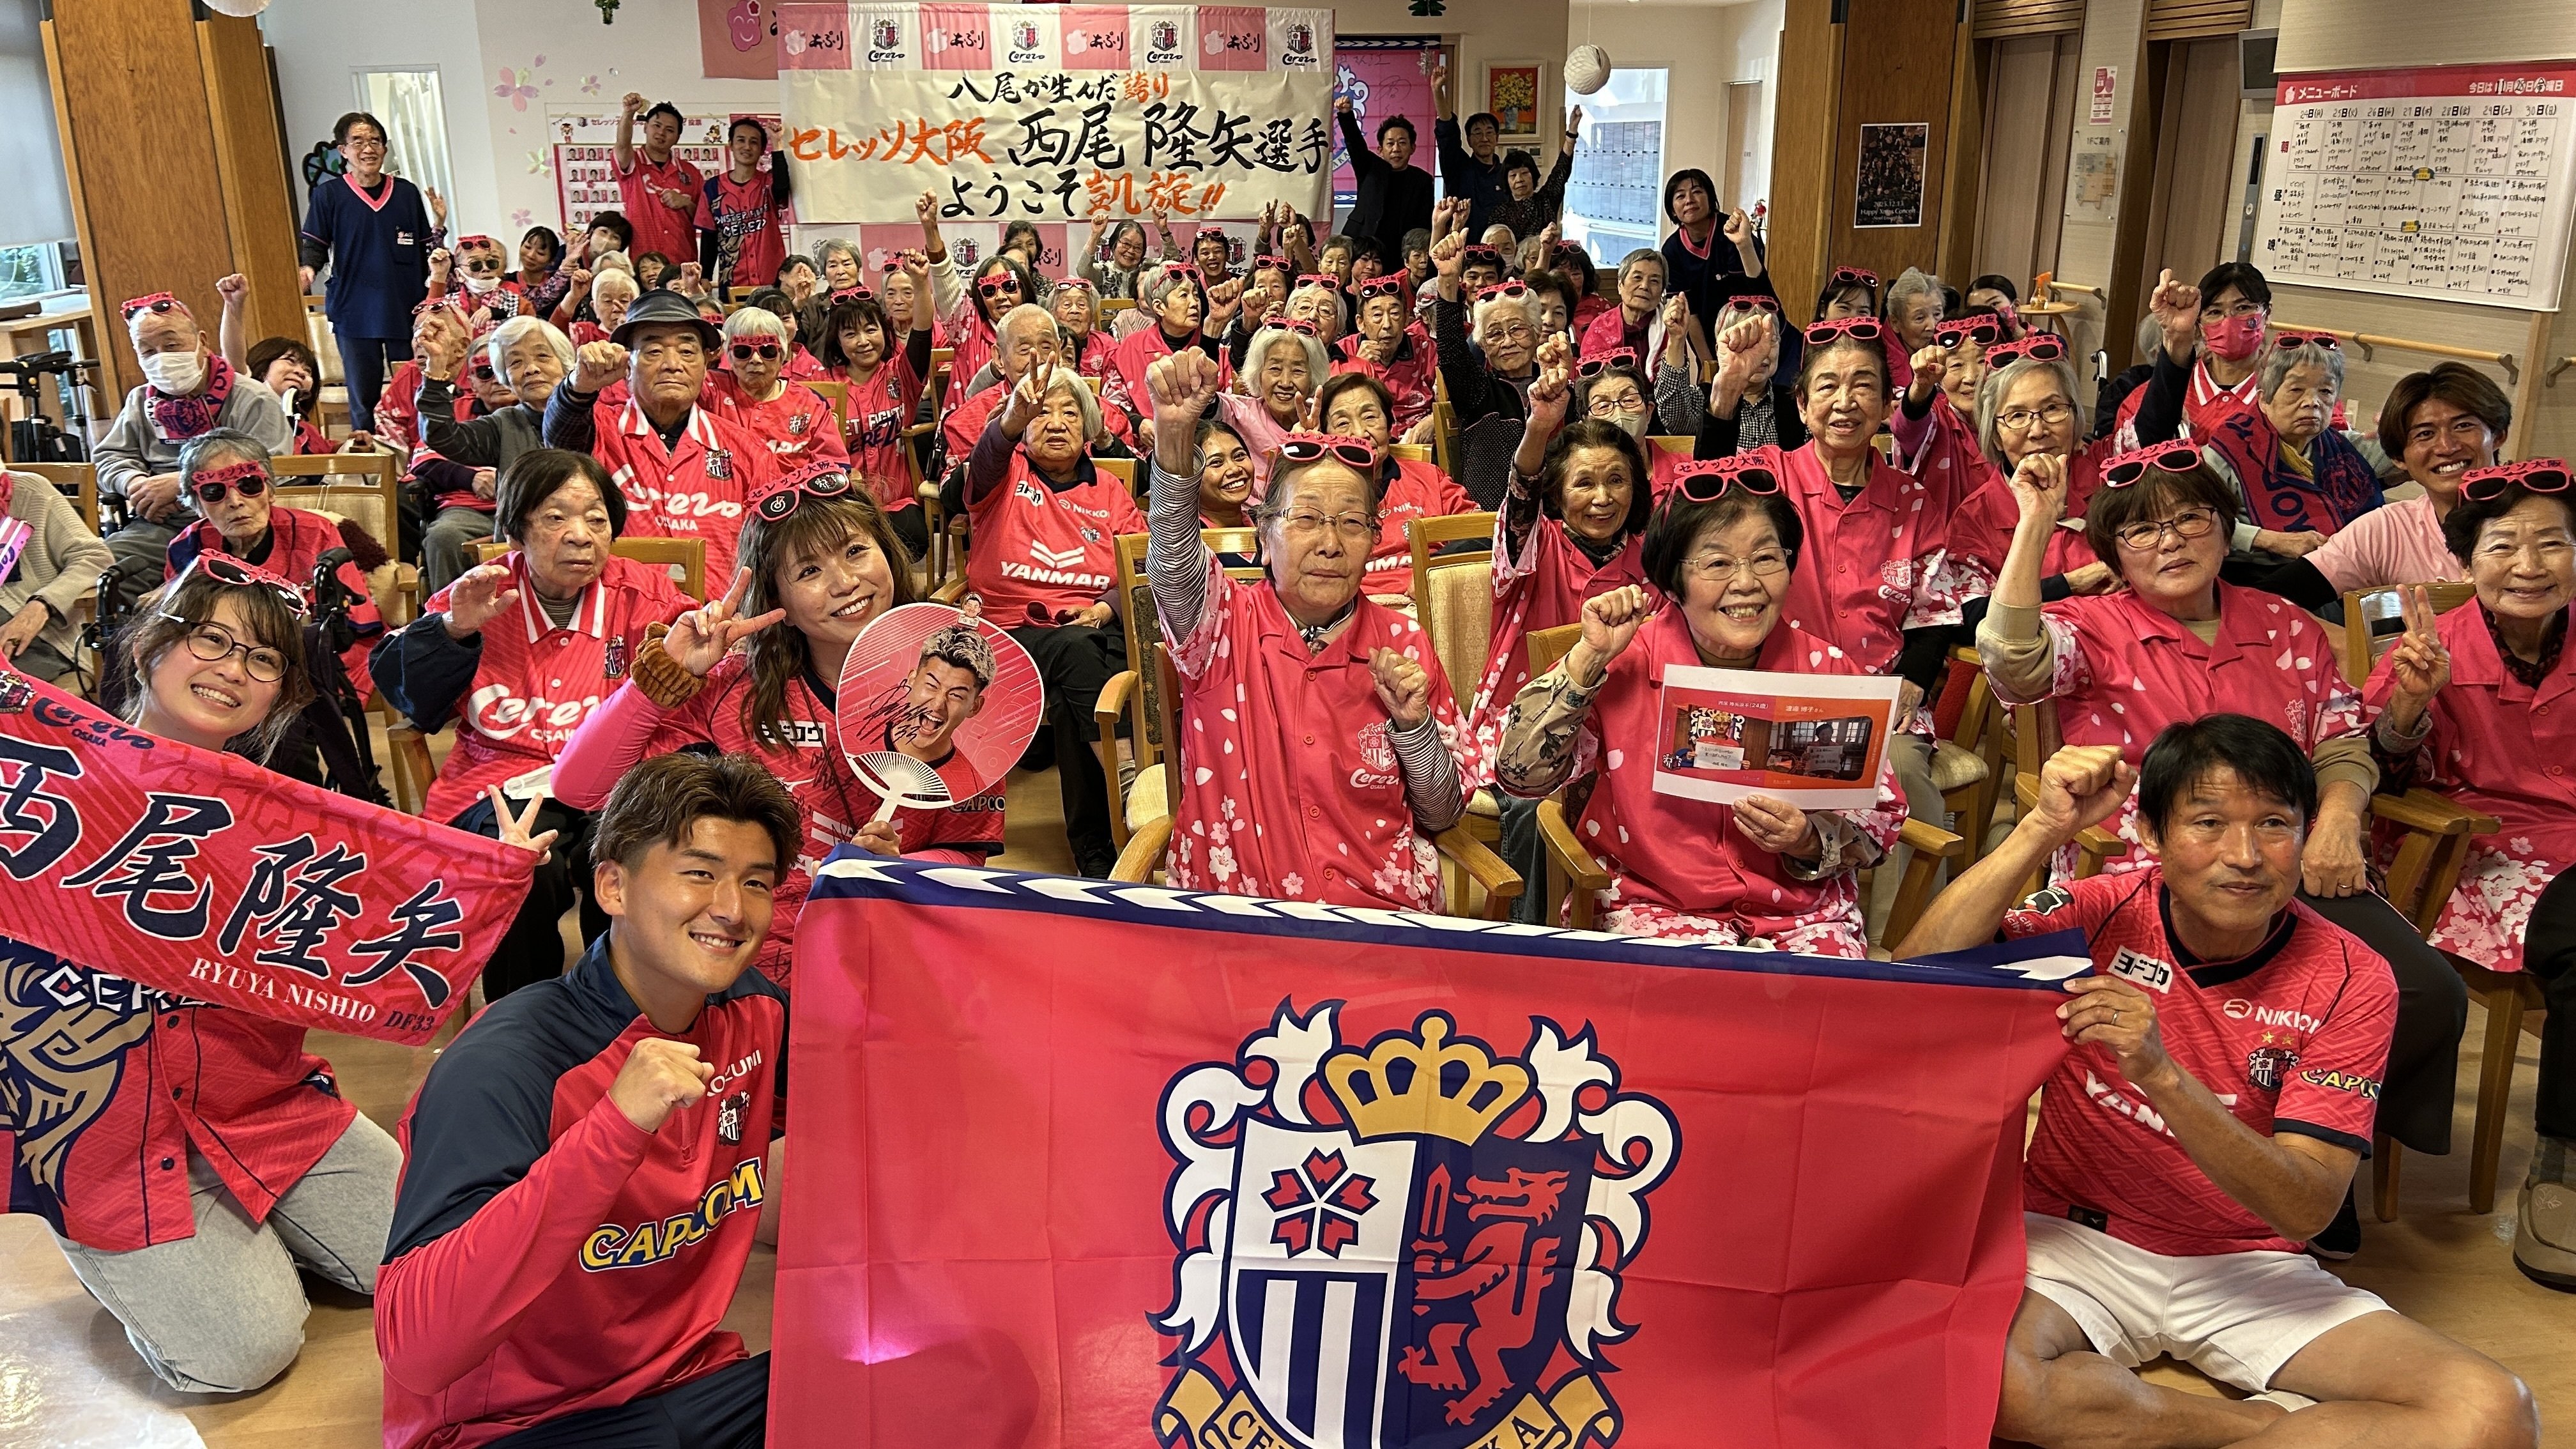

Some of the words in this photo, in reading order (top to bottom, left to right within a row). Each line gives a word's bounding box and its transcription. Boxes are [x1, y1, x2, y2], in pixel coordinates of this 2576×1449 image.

[2298, 84, 2358, 100] メニューボード
[789, 116, 995, 166] セレッソ大阪
[1000, 560, 1110, 590] YANMAR
[33, 696, 155, 749] Cerezo
[71, 728, 108, 747] OSAKA
[188, 956, 277, 1000] RYUYA
[284, 983, 378, 1025] NISHIO
[383, 1009, 436, 1034] DF33
[579, 1158, 765, 1271] CAPCOM
